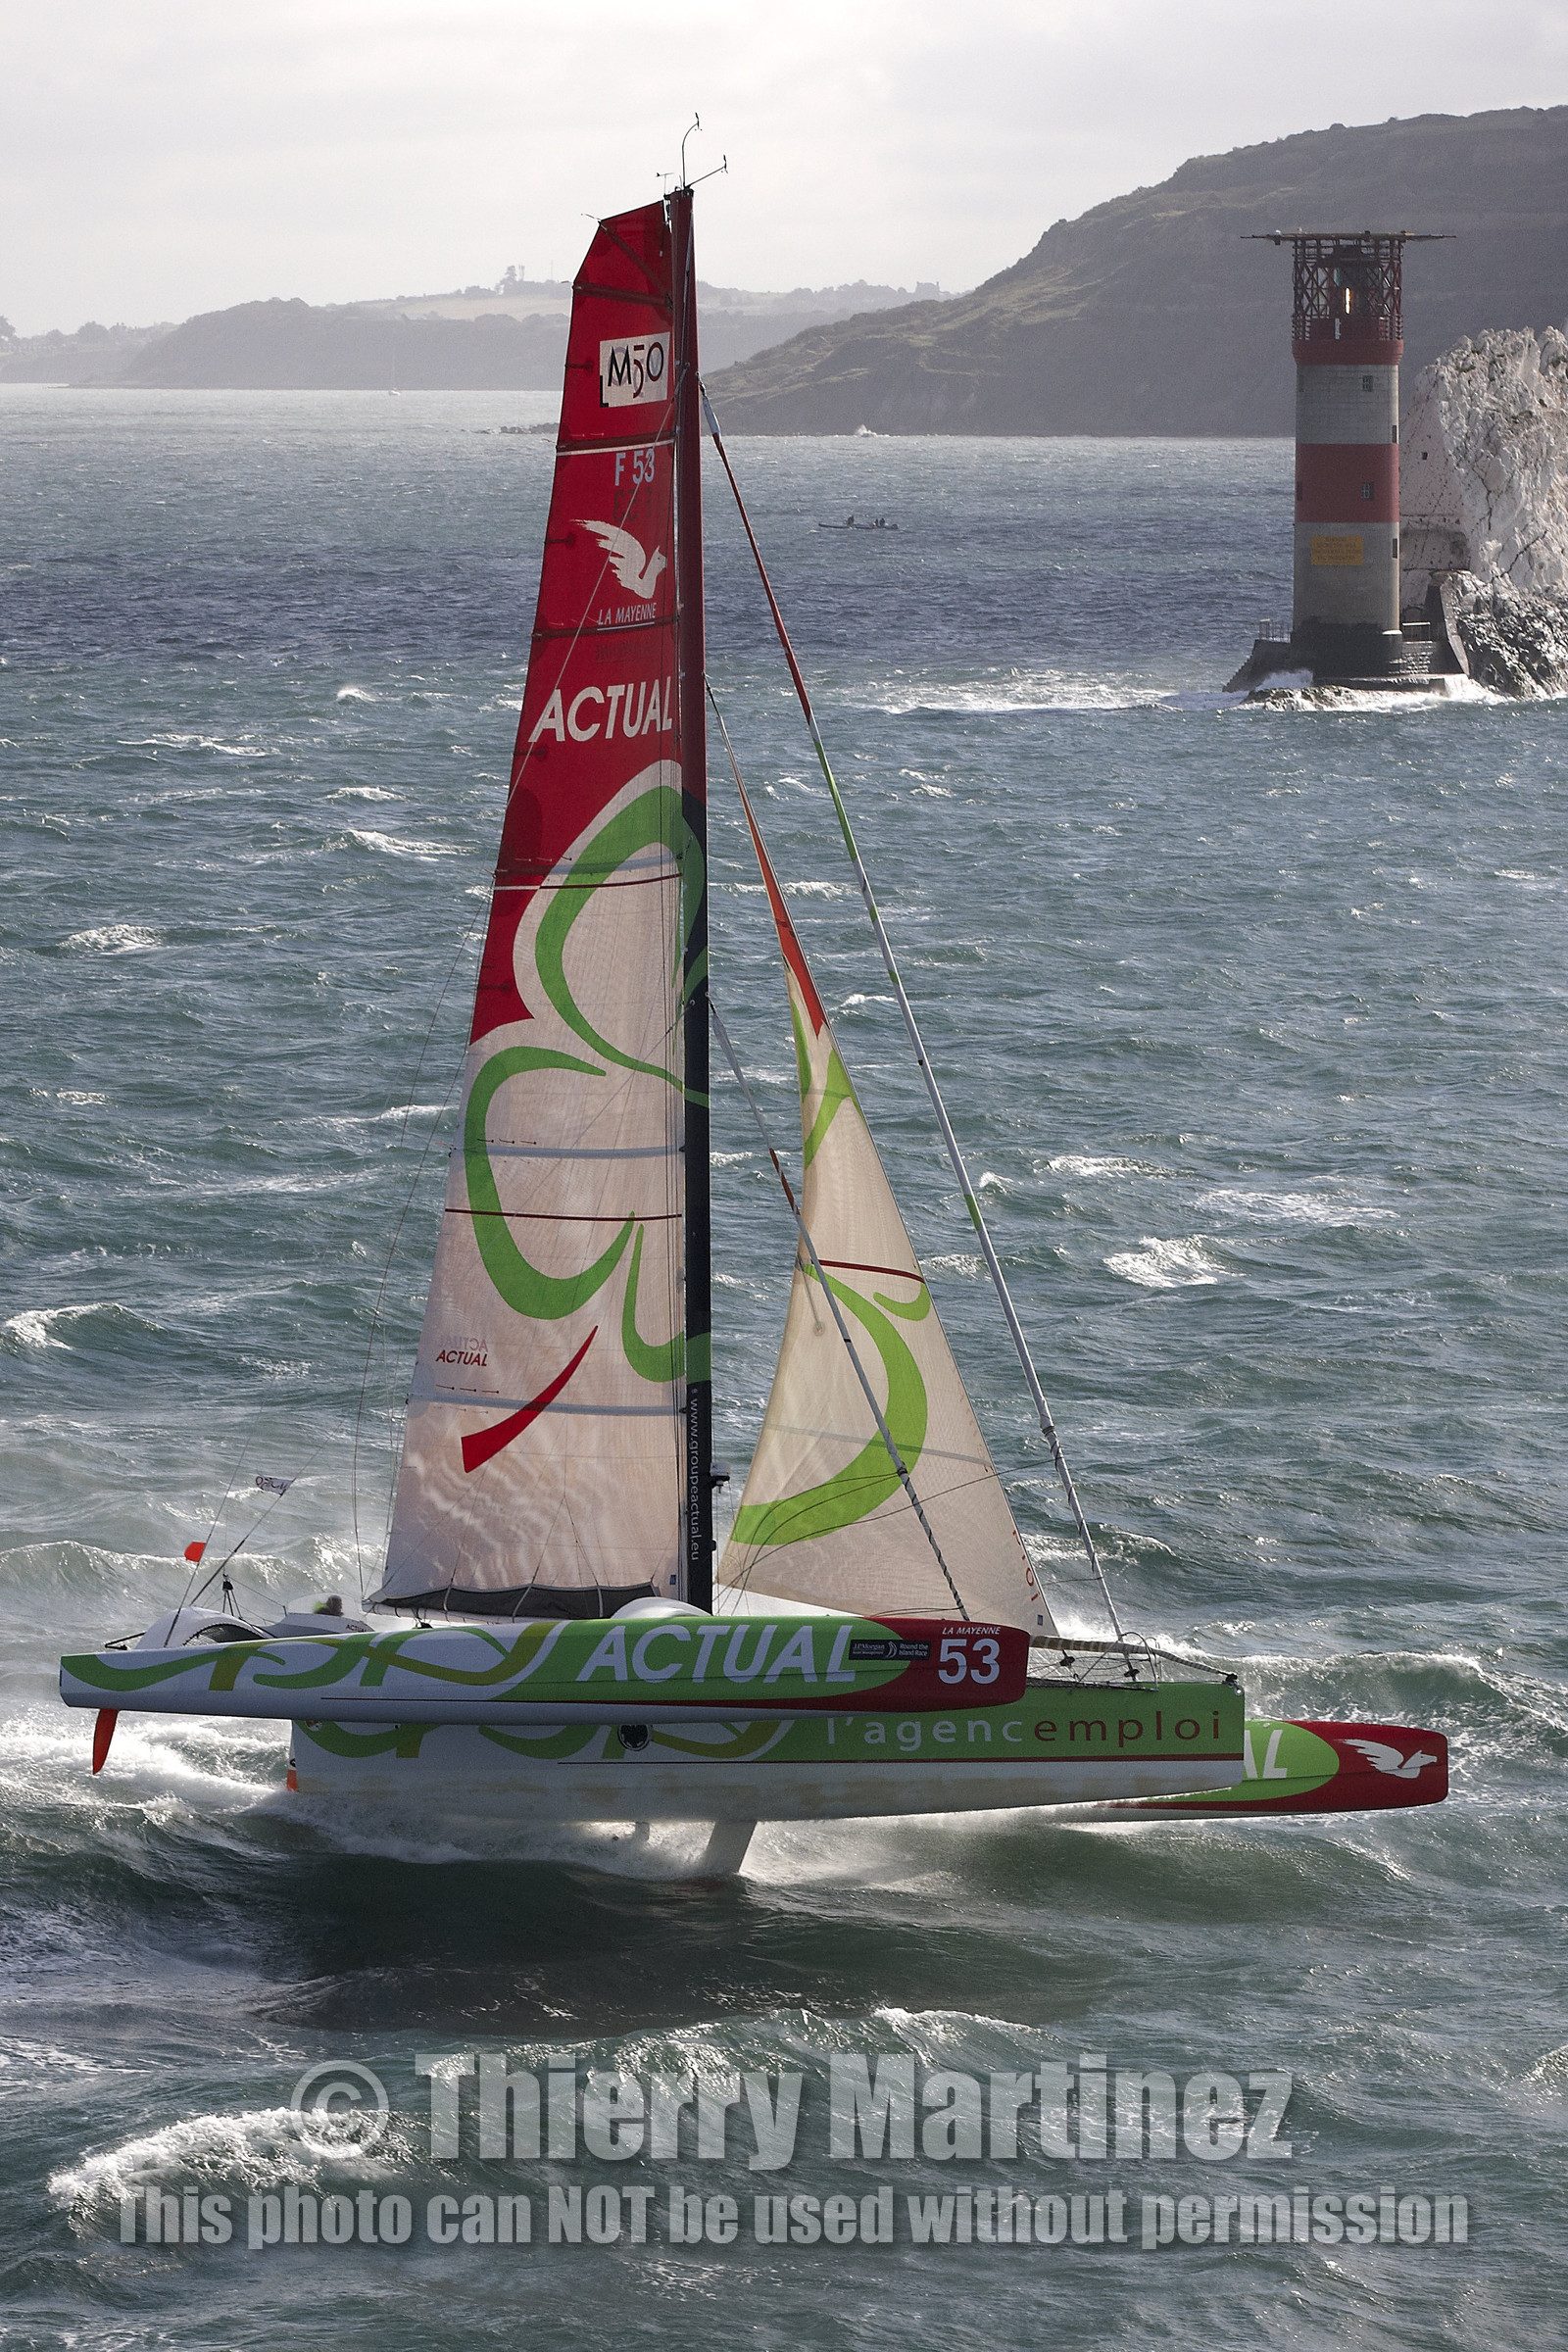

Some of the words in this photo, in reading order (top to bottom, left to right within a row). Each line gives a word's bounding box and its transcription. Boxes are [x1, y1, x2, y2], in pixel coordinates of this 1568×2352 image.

[608, 341, 664, 399] M50
[615, 452, 626, 486] F
[632, 448, 655, 484] 53
[597, 609, 612, 625] LA
[614, 602, 657, 623] MAYENNE
[527, 676, 672, 742] ACTUAL
[435, 1348, 488, 1367] ACTUAL
[688, 1398, 702, 1561] www.groupeactual.eu
[576, 1625, 857, 1684] ACTUAL
[938, 1638, 1000, 1684] 53
